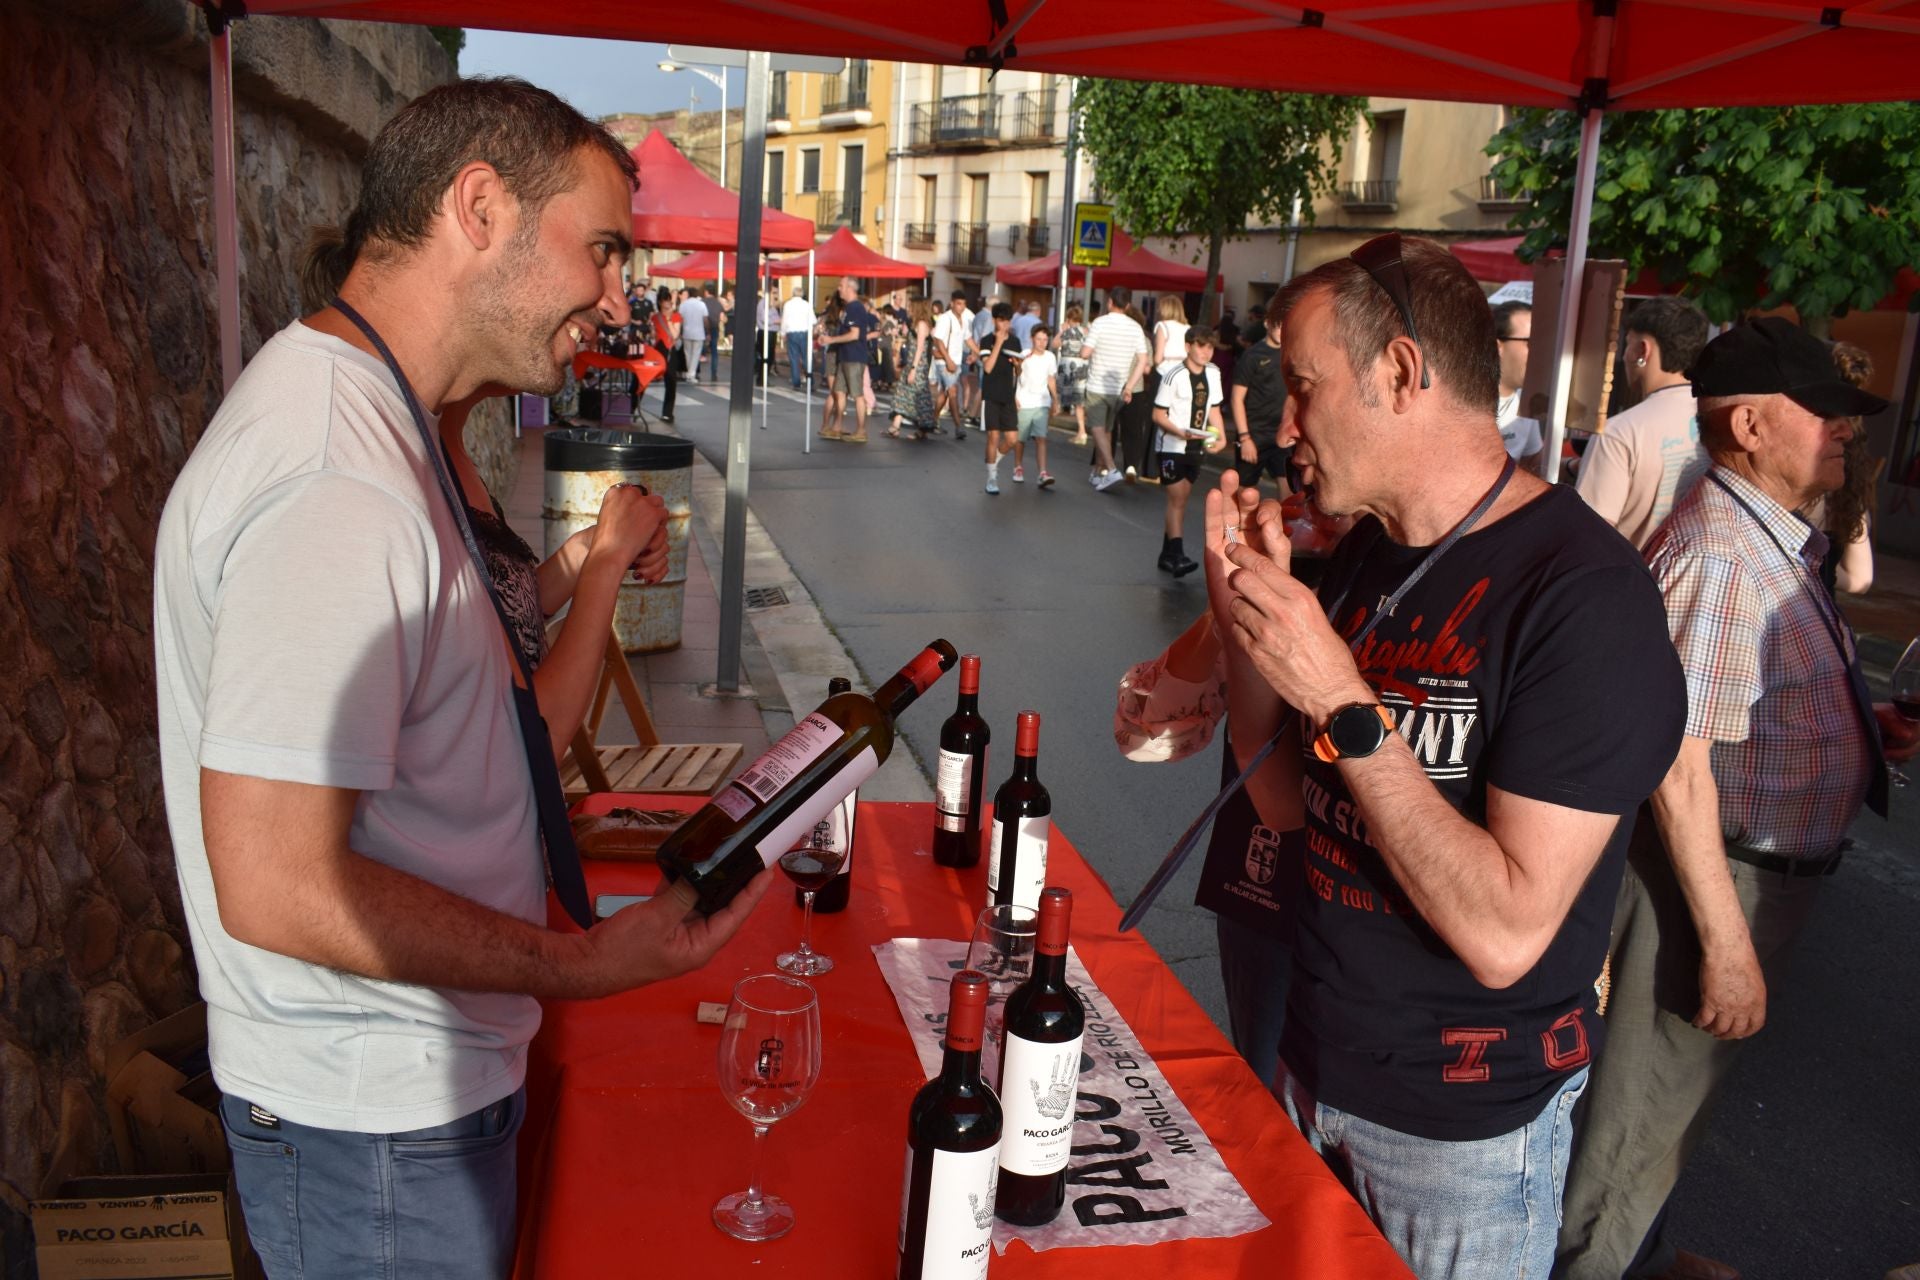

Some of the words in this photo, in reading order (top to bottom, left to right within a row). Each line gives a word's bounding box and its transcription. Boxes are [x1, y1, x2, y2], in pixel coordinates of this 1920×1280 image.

[1231, 885, 1250, 898] VILLAR
[1257, 897, 1281, 912] ARNEDO
[1340, 884, 1375, 912] YOU
[1106, 1050, 1141, 1072] DE
[1125, 1076, 1197, 1155] MURILLO
[1023, 1129, 1049, 1138] PACO
[40, 1201, 87, 1210] CRIANZA
[98, 1200, 147, 1209] CRIANZA
[171, 1195, 218, 1205] CRIANZA
[57, 1227, 115, 1242] PACO
[120, 1220, 205, 1240] GARCÍA
[961, 1243, 985, 1259] PACO
